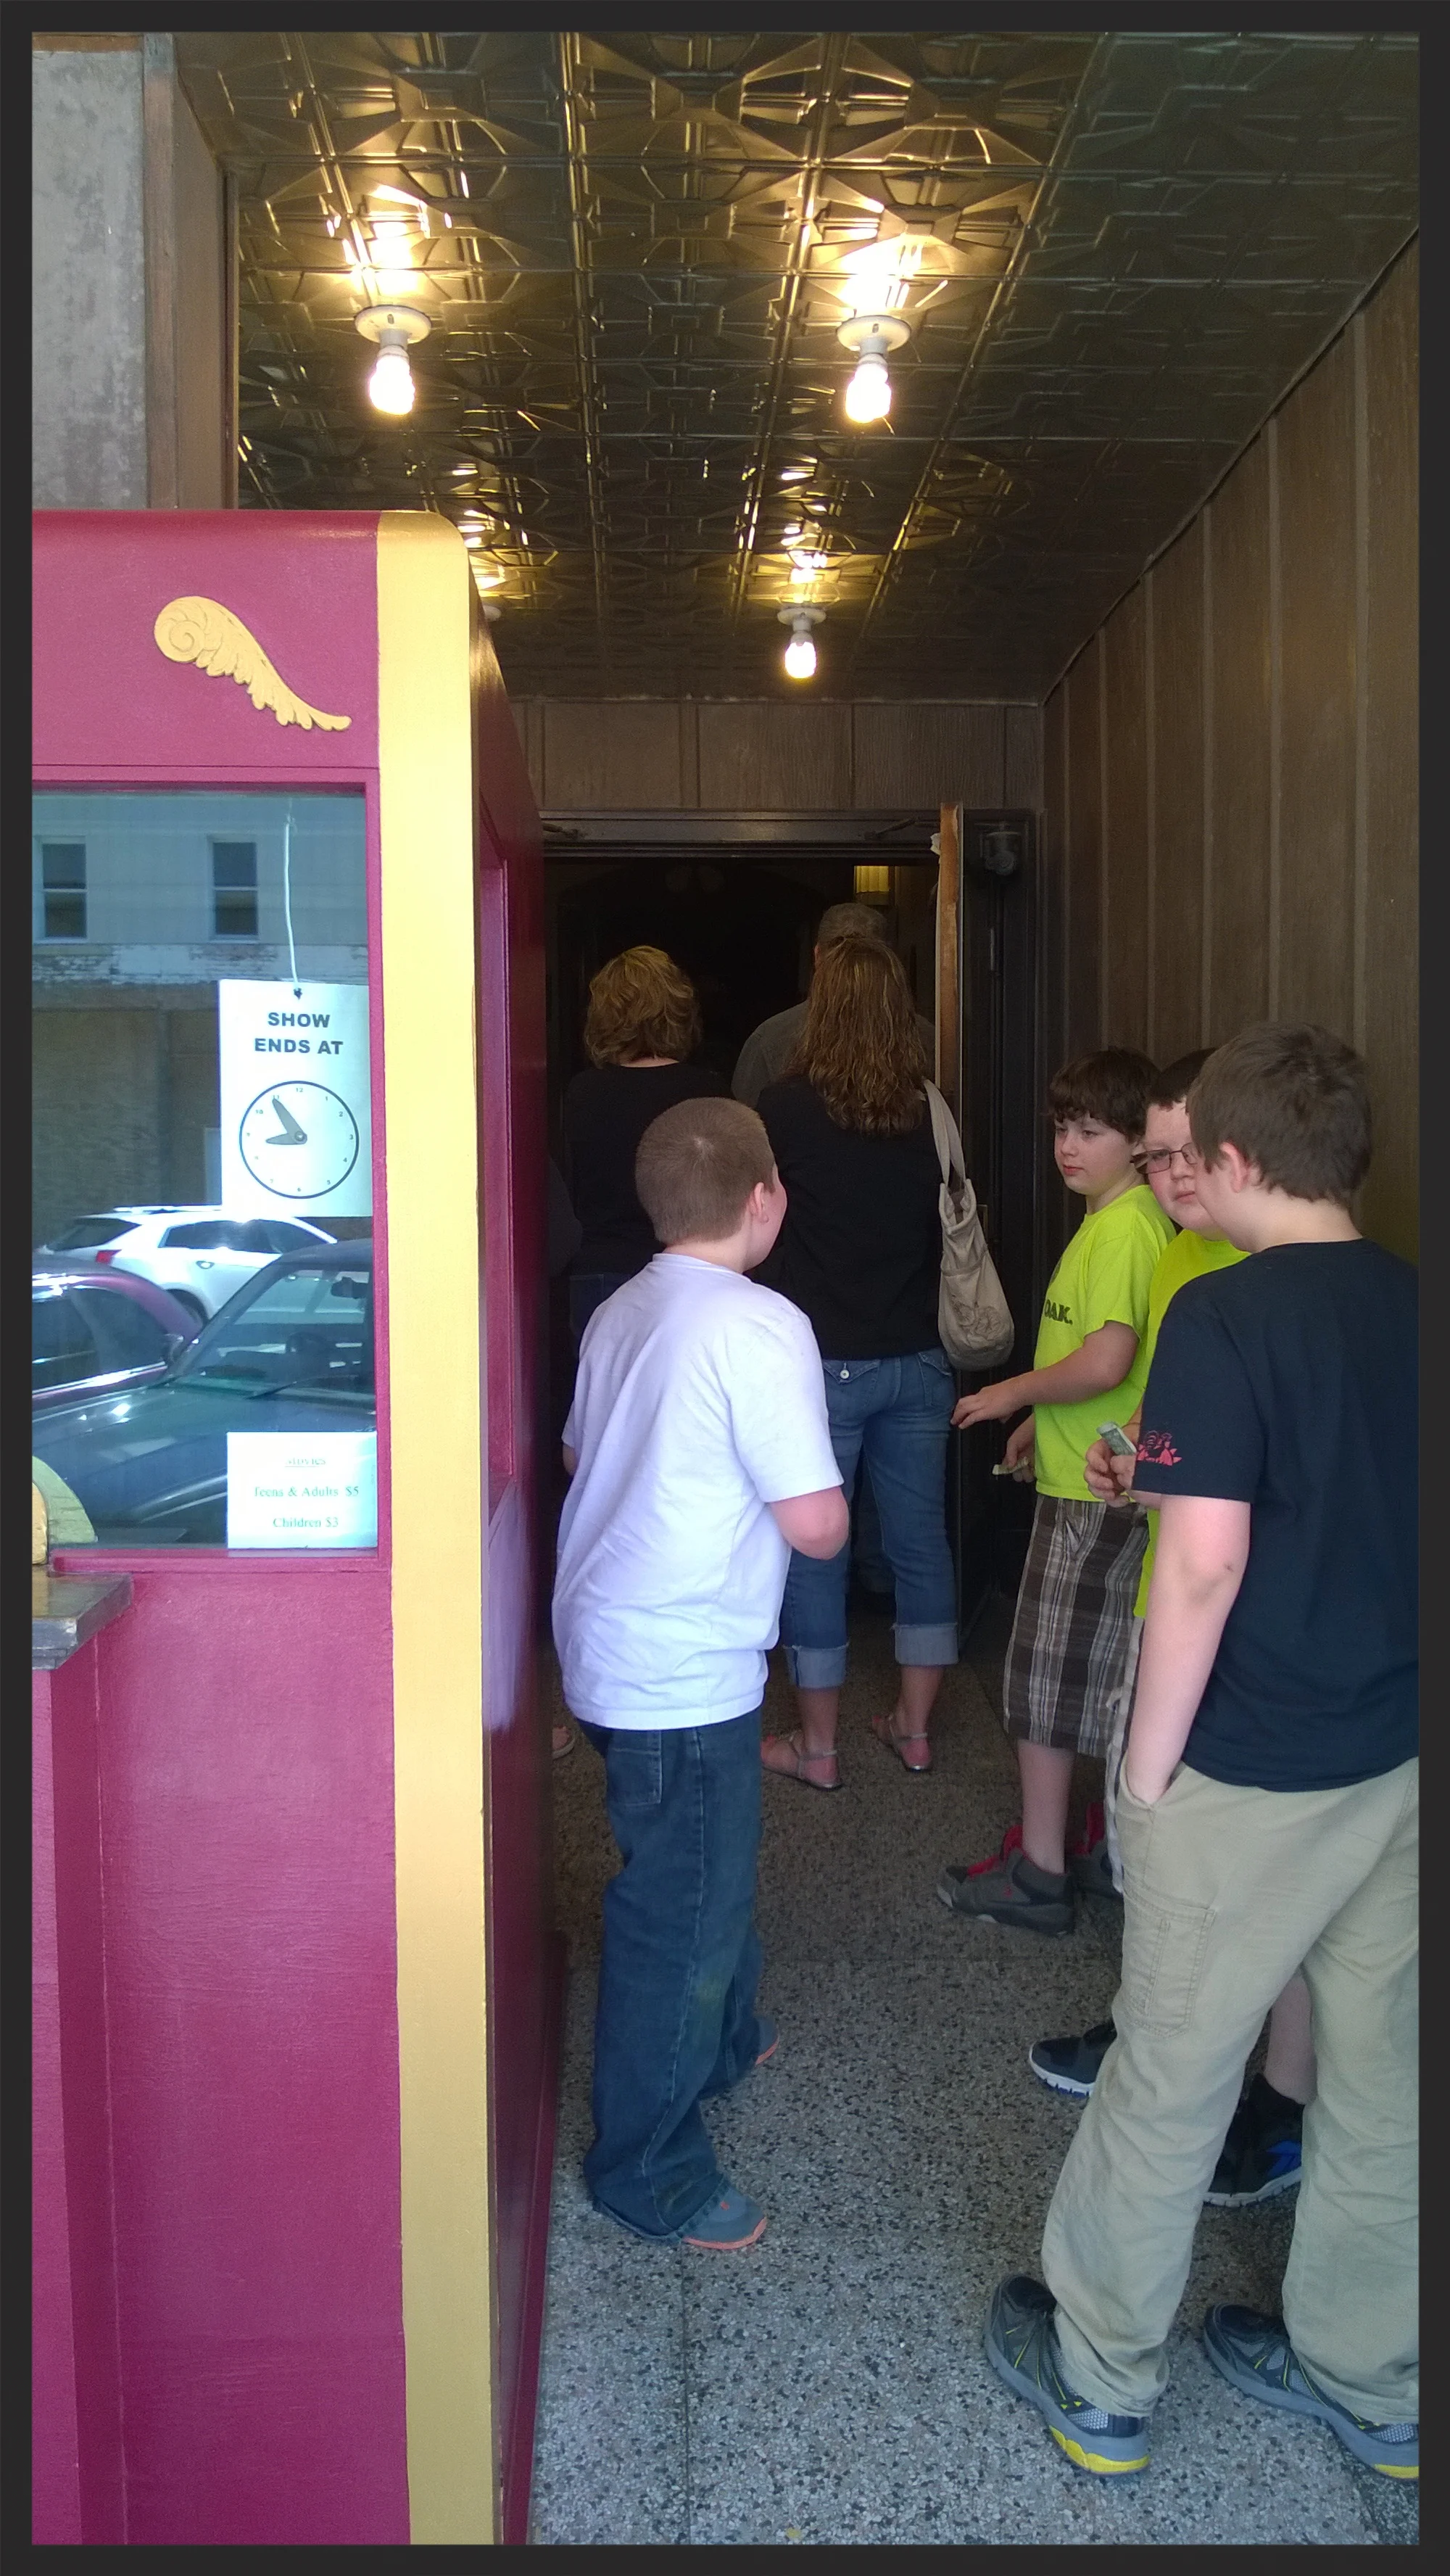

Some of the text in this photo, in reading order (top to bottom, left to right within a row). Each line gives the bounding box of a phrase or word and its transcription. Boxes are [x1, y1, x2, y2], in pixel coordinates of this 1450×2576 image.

[268, 1012, 331, 1028] SHOW
[254, 1038, 344, 1054] ENDS AT
[254, 1485, 359, 1497] Teens & Adults $5
[273, 1516, 339, 1527] Children $3
